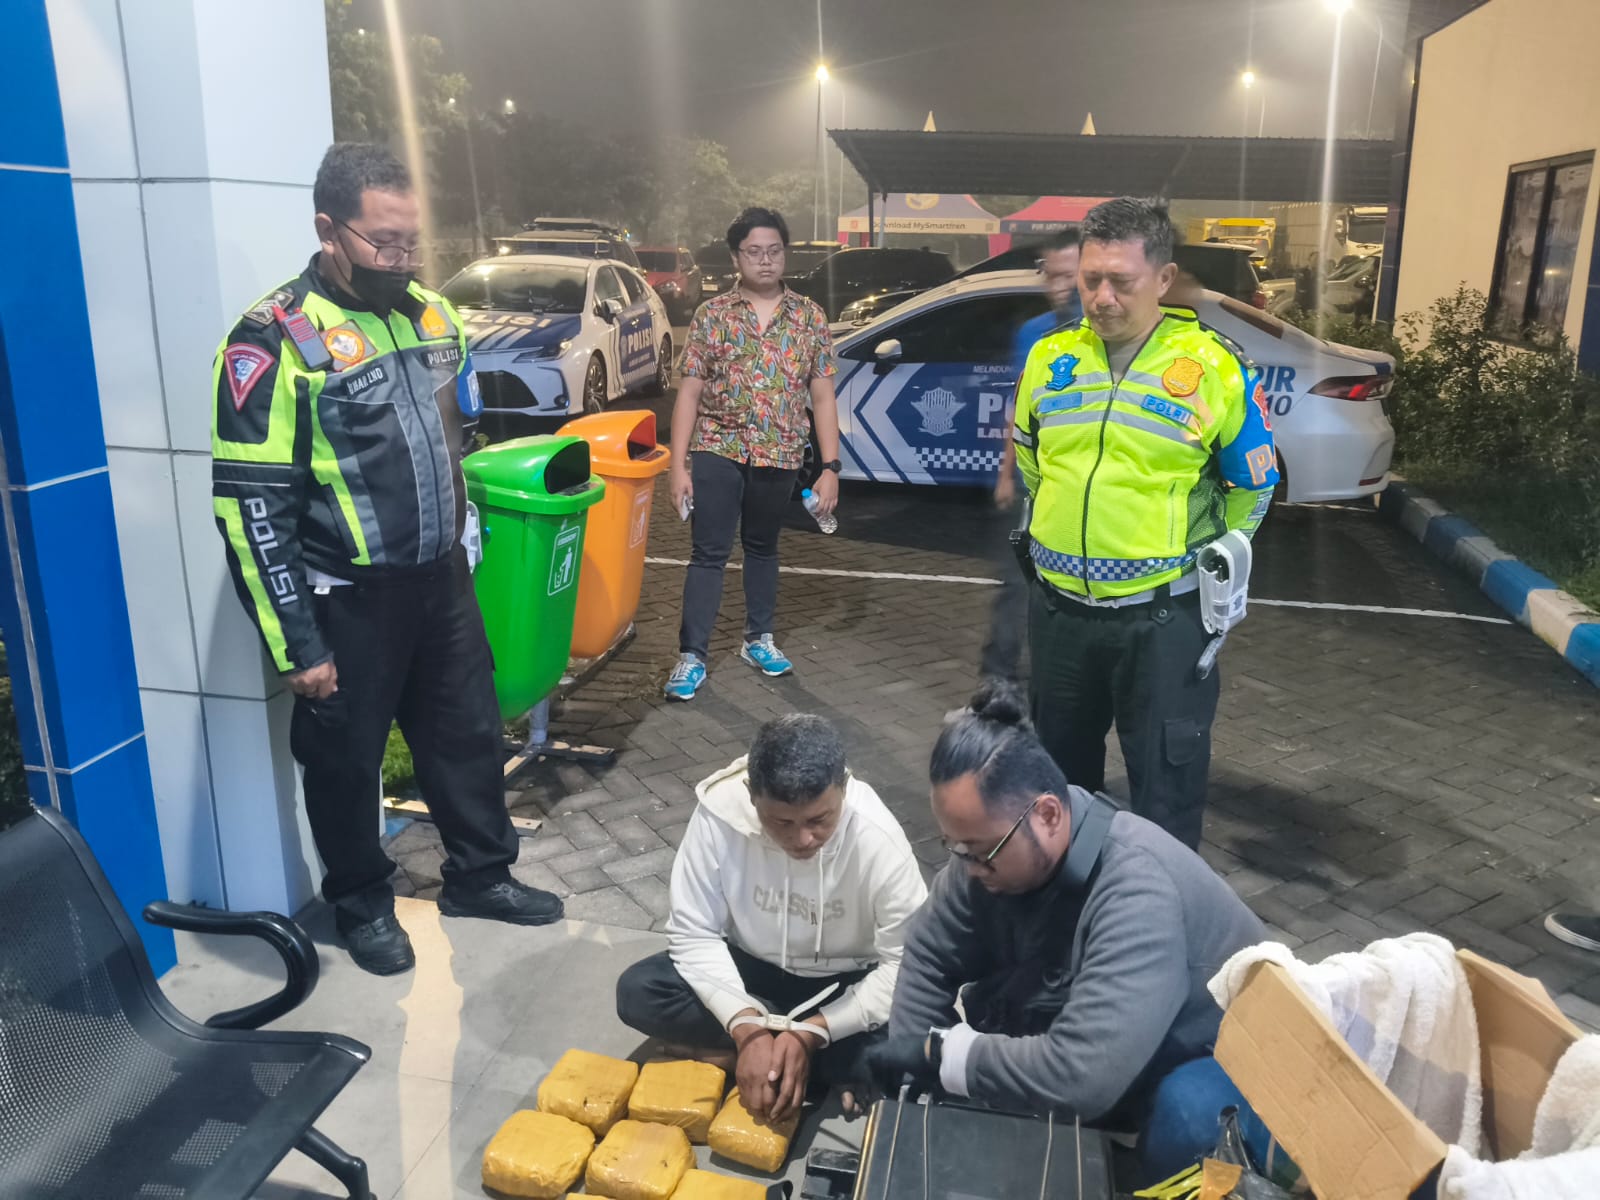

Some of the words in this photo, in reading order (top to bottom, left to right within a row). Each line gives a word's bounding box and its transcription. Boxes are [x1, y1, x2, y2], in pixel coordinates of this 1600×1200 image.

[427, 348, 459, 365] POLISI
[1145, 396, 1190, 424] POLRI
[244, 497, 298, 605] POLISI
